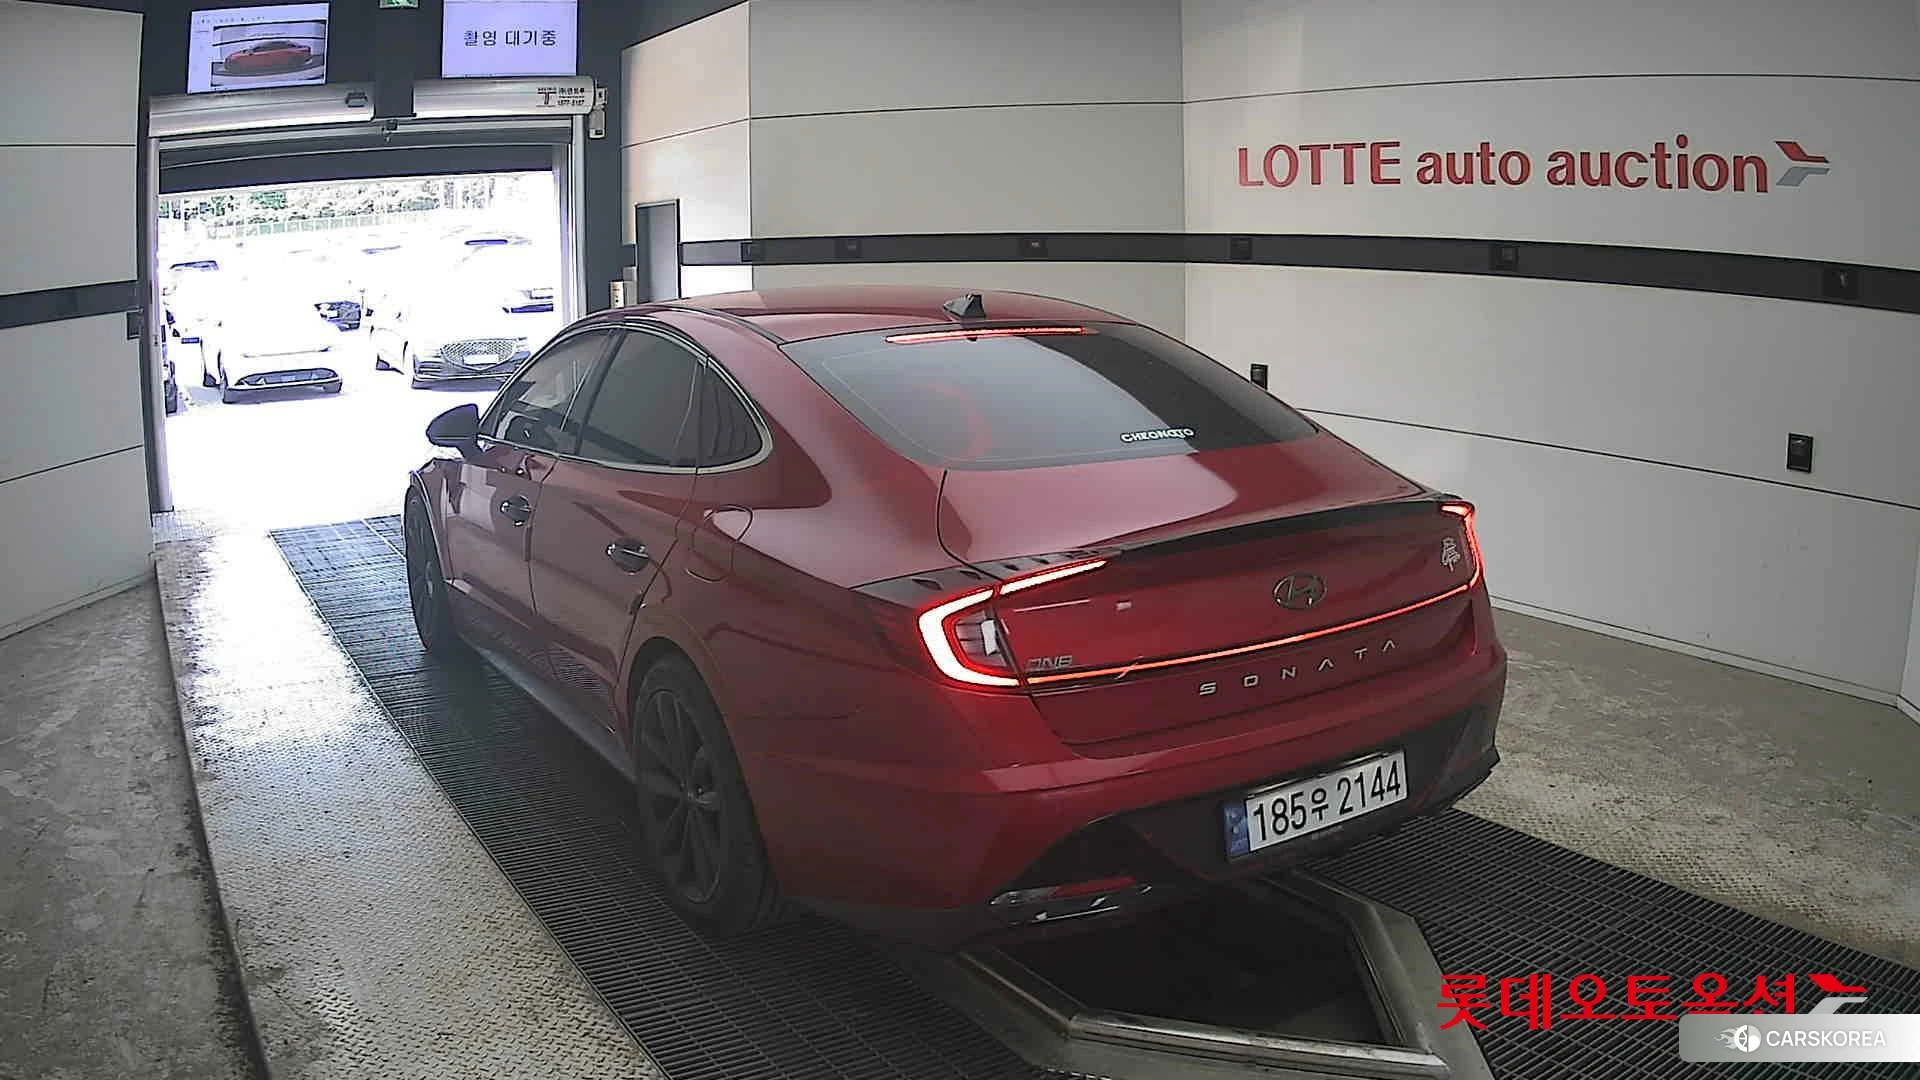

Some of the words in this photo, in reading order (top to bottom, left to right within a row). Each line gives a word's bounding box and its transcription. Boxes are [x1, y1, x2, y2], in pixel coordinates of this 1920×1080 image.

[505, 29, 557, 47] 대기중
[1238, 140, 1401, 188] LOTTE
[1416, 141, 1532, 187] auto
[1546, 133, 1769, 194] auction
[1199, 639, 1396, 696] SONATA
[1253, 788, 1329, 841] 185우
[1336, 760, 1401, 816] 2144
